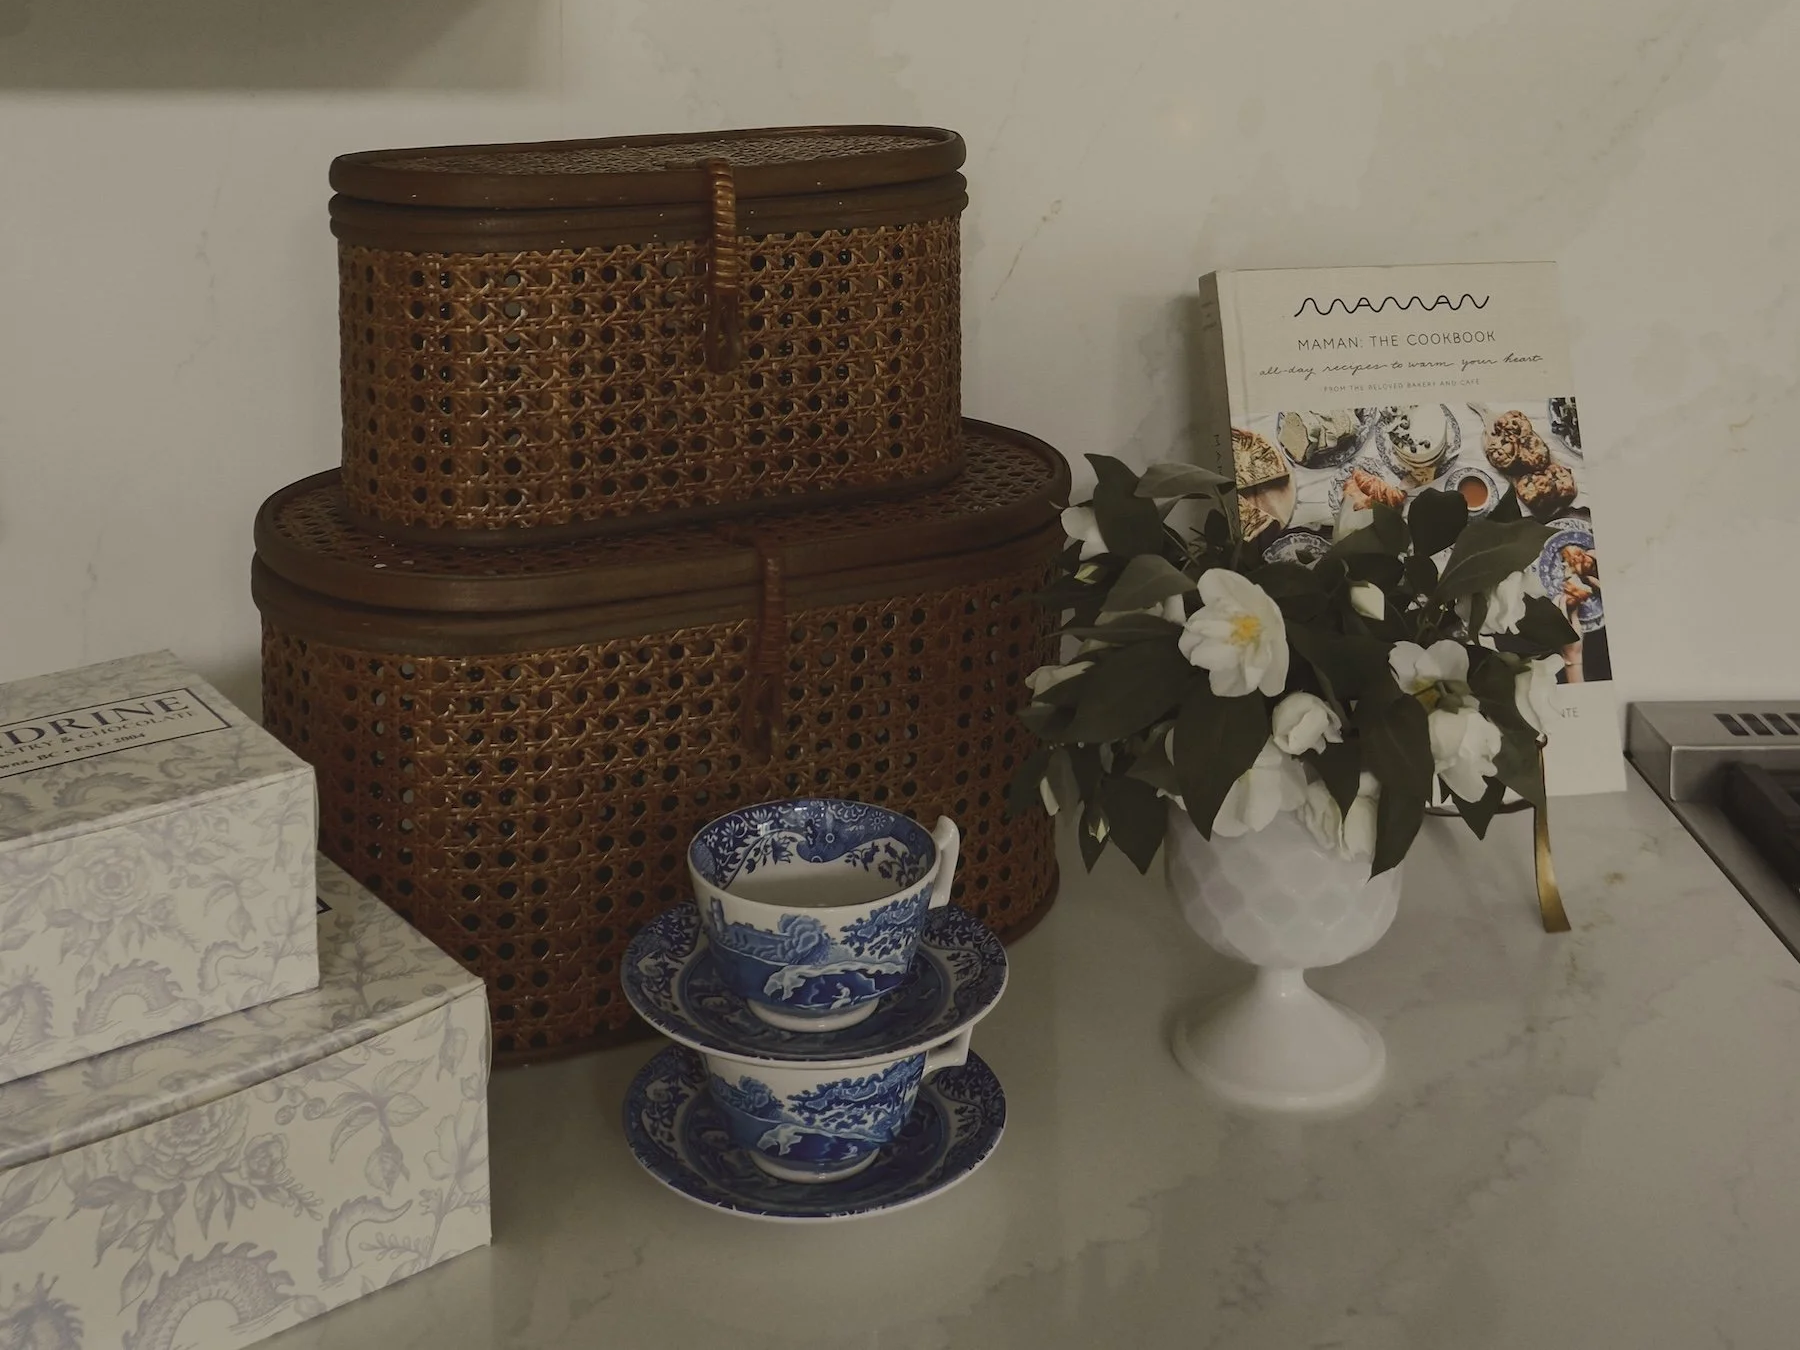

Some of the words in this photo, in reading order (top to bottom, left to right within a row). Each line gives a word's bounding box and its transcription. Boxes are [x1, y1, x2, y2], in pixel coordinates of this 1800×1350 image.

[1297, 336, 1364, 351] MAMAN:
[1369, 334, 1400, 348] THE
[1406, 330, 1497, 347] COOKBOOK
[1259, 363, 1318, 381] all-day
[1323, 361, 1389, 376] recipes
[1391, 359, 1404, 370] to
[1407, 360, 1455, 369] warm
[1460, 357, 1499, 373] your
[1502, 352, 1545, 363] heart
[1323, 385, 1347, 393] FROM
[1349, 384, 1366, 392] THE
[1368, 382, 1405, 391] BELOVED
[1406, 381, 1438, 389] BAKERY
[1440, 380, 1460, 388] AND
[0, 697, 190, 748] DRINE
[59, 736, 76, 744] &
[79, 711, 198, 738] CHOCOLATE
[37, 751, 60, 761] BC
[74, 741, 110, 753] EST.
[113, 732, 146, 744] 2004
